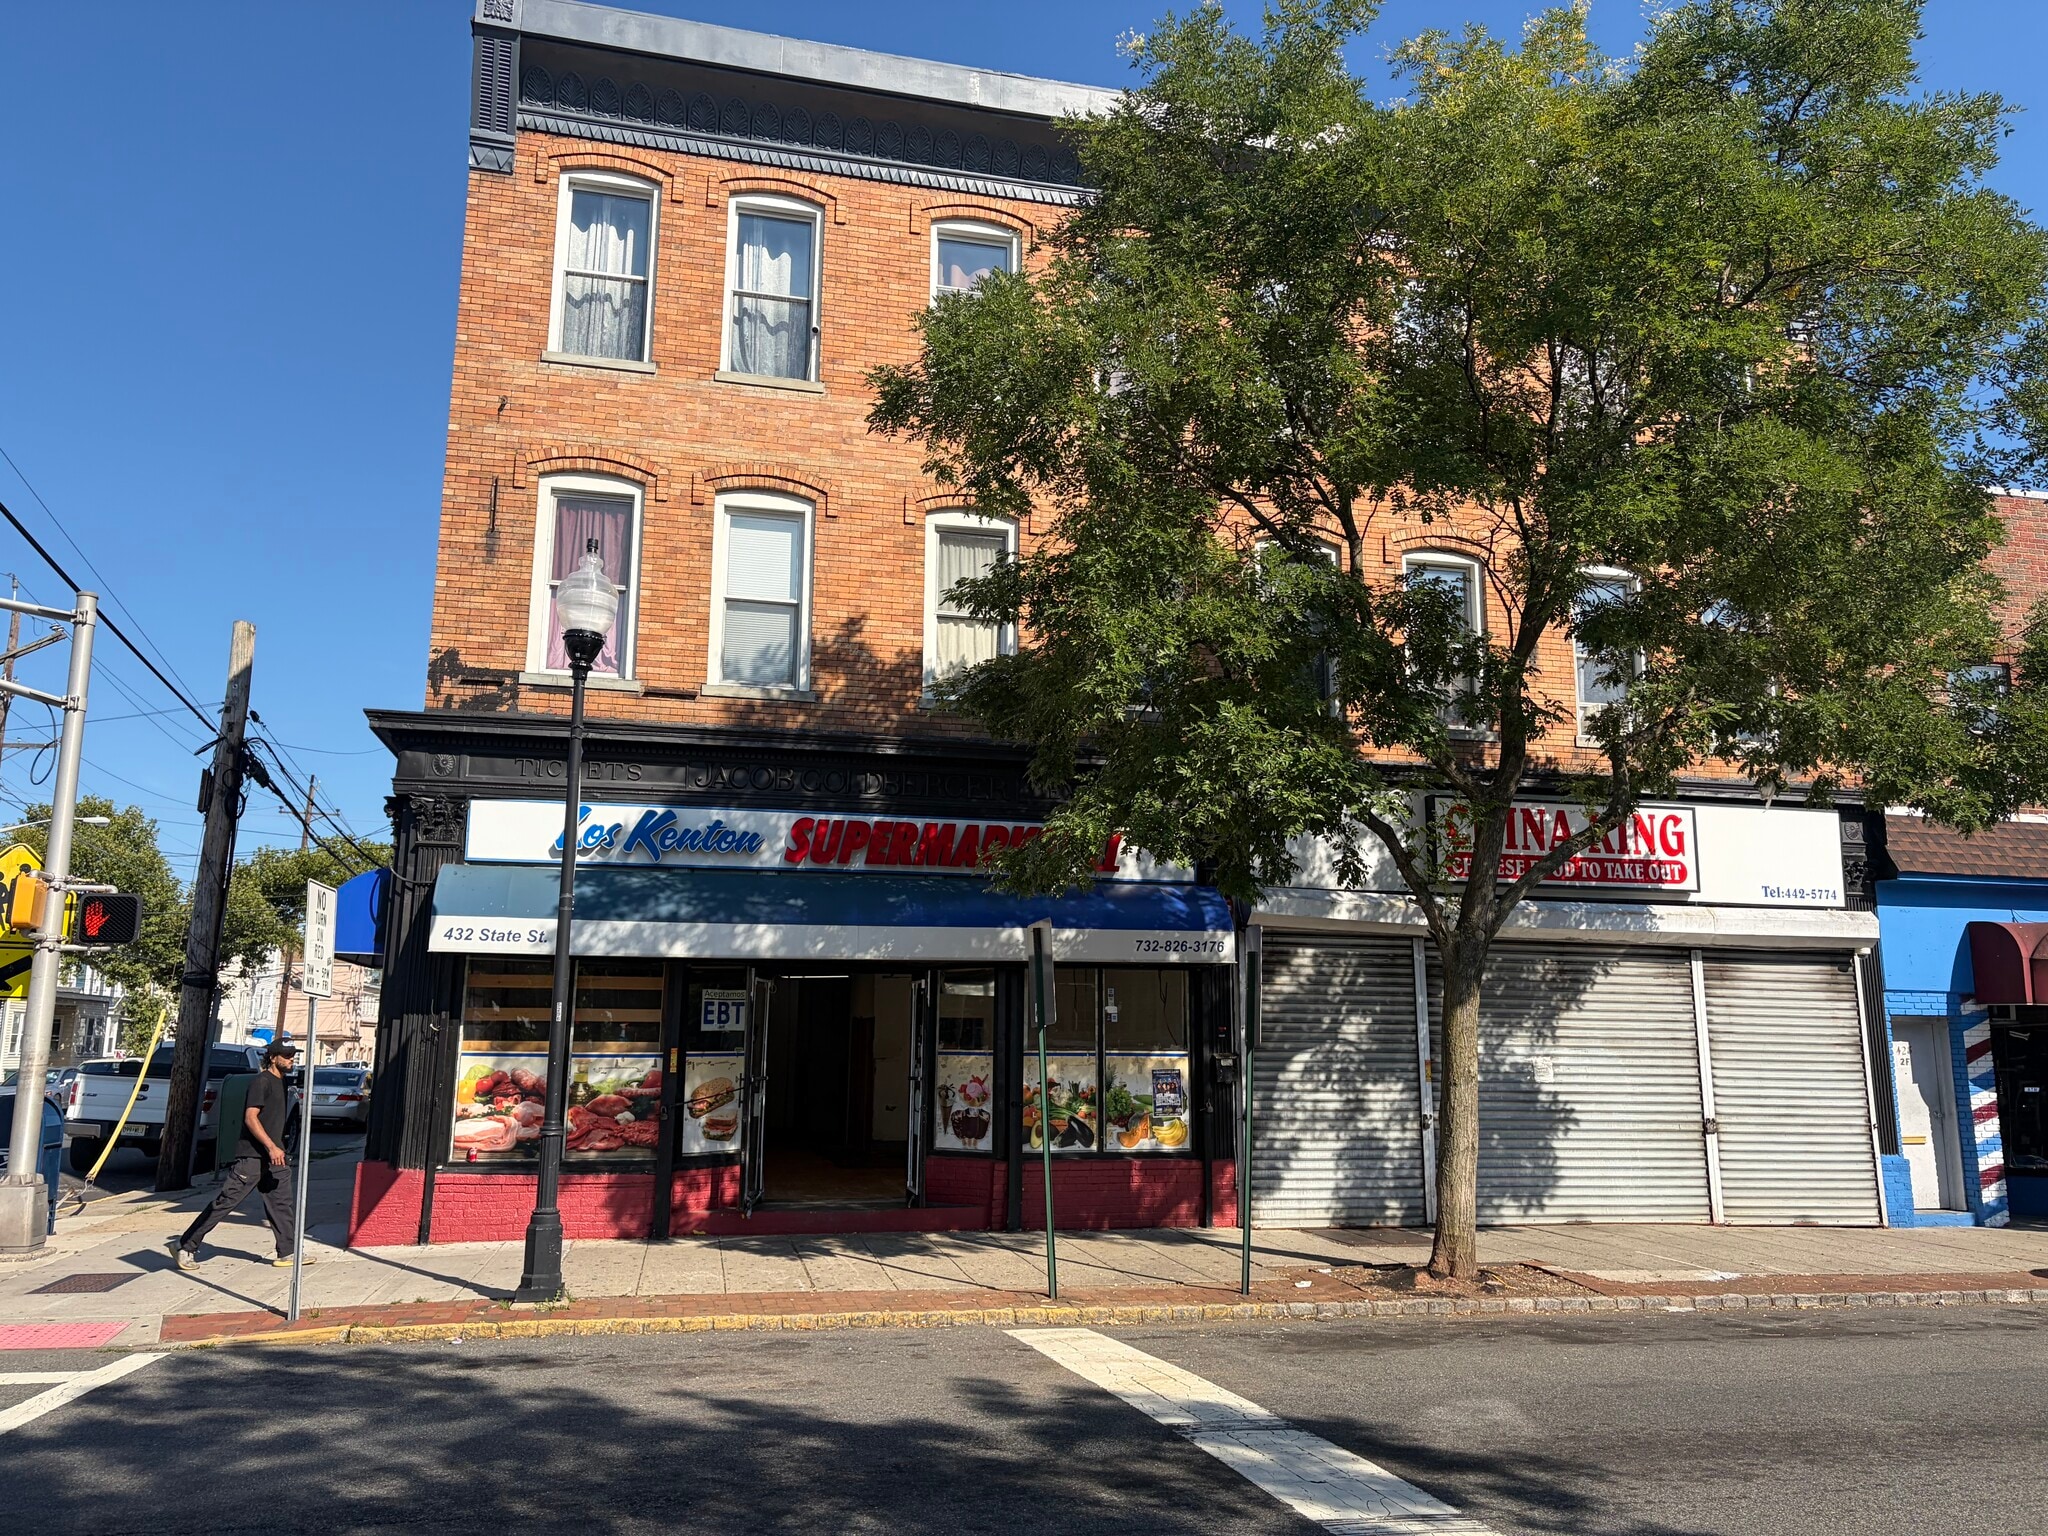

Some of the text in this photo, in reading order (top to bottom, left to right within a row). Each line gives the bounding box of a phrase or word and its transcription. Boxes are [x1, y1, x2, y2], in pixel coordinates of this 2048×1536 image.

[514, 758, 642, 781] TICETS
[693, 765, 795, 791] JACOB
[622, 809, 768, 863] Kenton
[1445, 804, 1576, 853] CINA
[1579, 861, 1600, 878] TO
[1604, 862, 1645, 880] TAKE
[1648, 863, 1682, 881] OUT
[316, 888, 327, 911] NO
[1761, 885, 1837, 900] Tel:442-5774
[315, 910, 328, 927] TURN
[443, 927, 549, 943] 432 State St.
[314, 943, 325, 960] RED
[1135, 939, 1225, 953] 732-826-3176
[704, 990, 745, 998] Aceptamos
[703, 1001, 745, 1025] EBT
